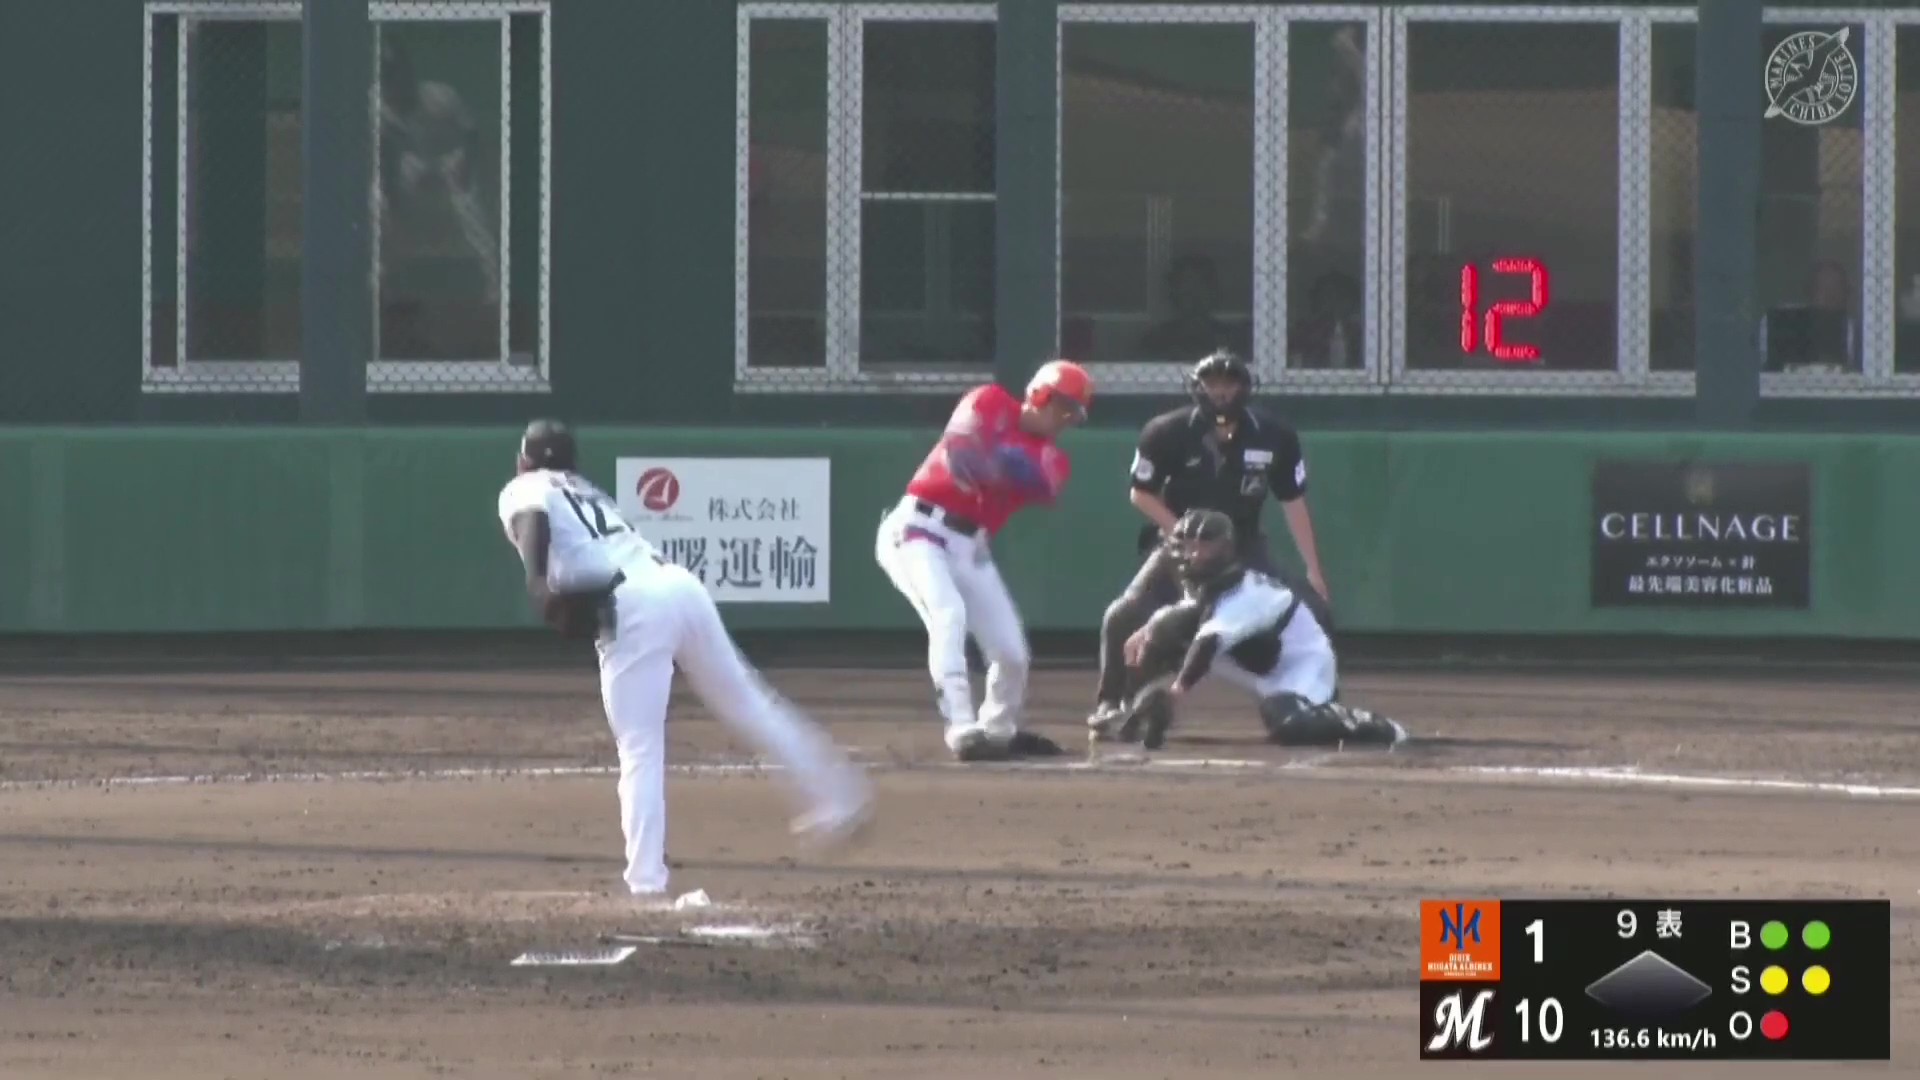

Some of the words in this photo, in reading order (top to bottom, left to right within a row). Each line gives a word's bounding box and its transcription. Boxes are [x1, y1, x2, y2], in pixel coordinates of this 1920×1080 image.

[1461, 258, 1549, 361] 12
[562, 487, 635, 541] 12
[708, 496, 801, 523] 株式会社
[1601, 512, 1799, 542] CELLNAGE
